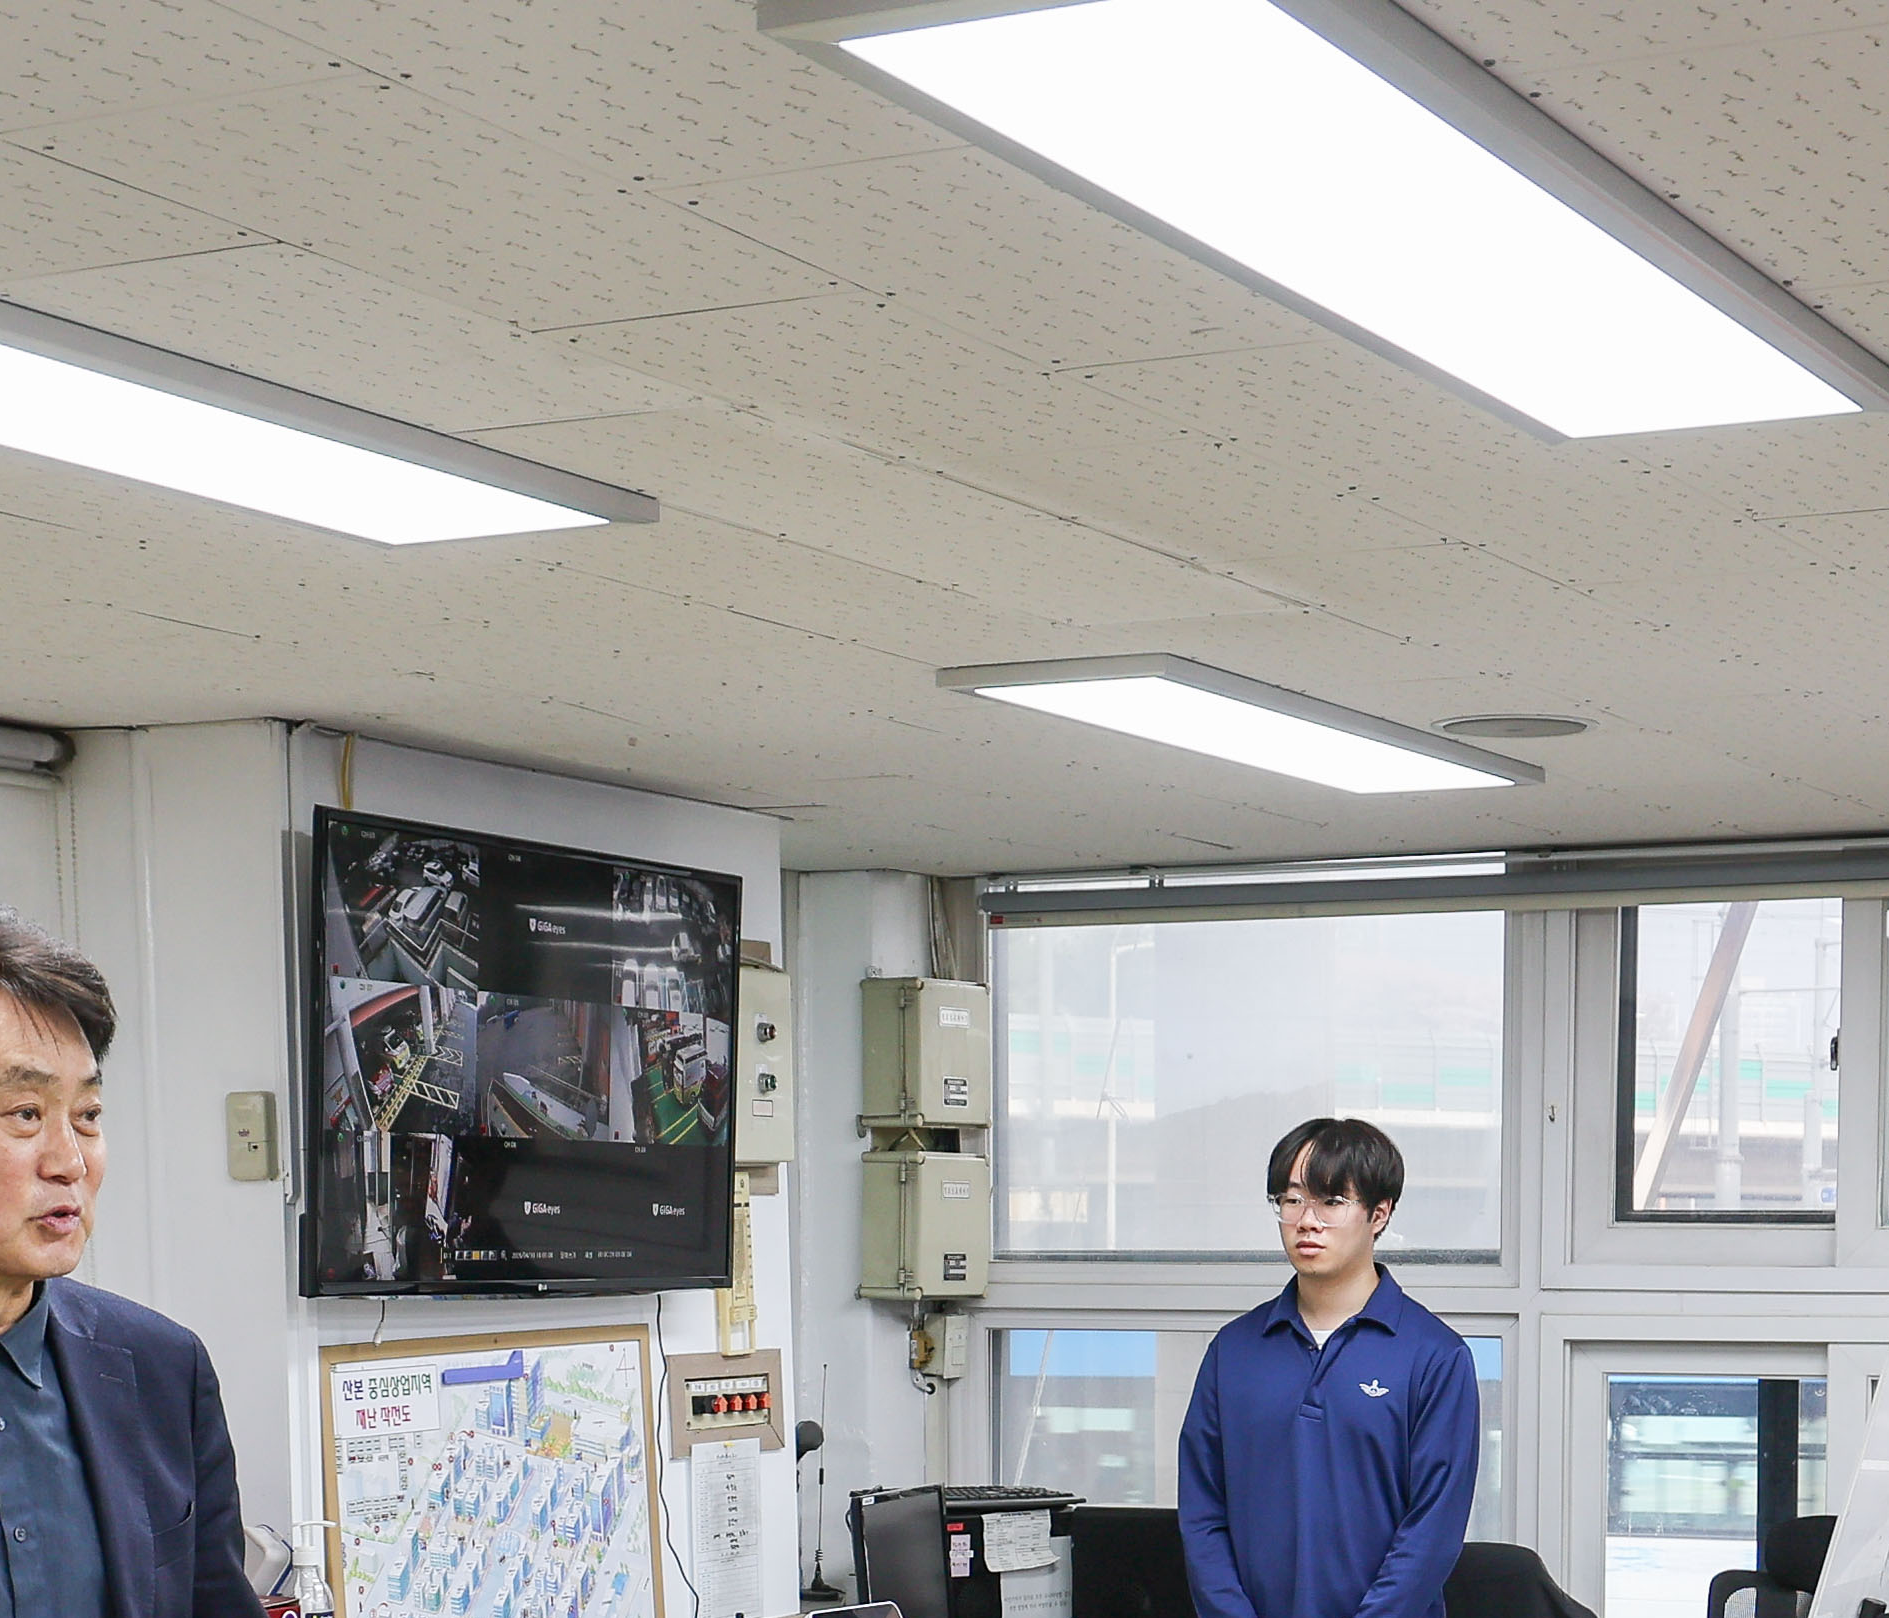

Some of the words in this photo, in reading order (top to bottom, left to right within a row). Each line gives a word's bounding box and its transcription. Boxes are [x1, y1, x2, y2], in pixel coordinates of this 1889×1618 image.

[342, 1380, 364, 1401] 산본
[368, 1373, 432, 1400] 중심상업지역
[355, 1407, 377, 1430] 재난
[380, 1405, 412, 1427] 작전도
